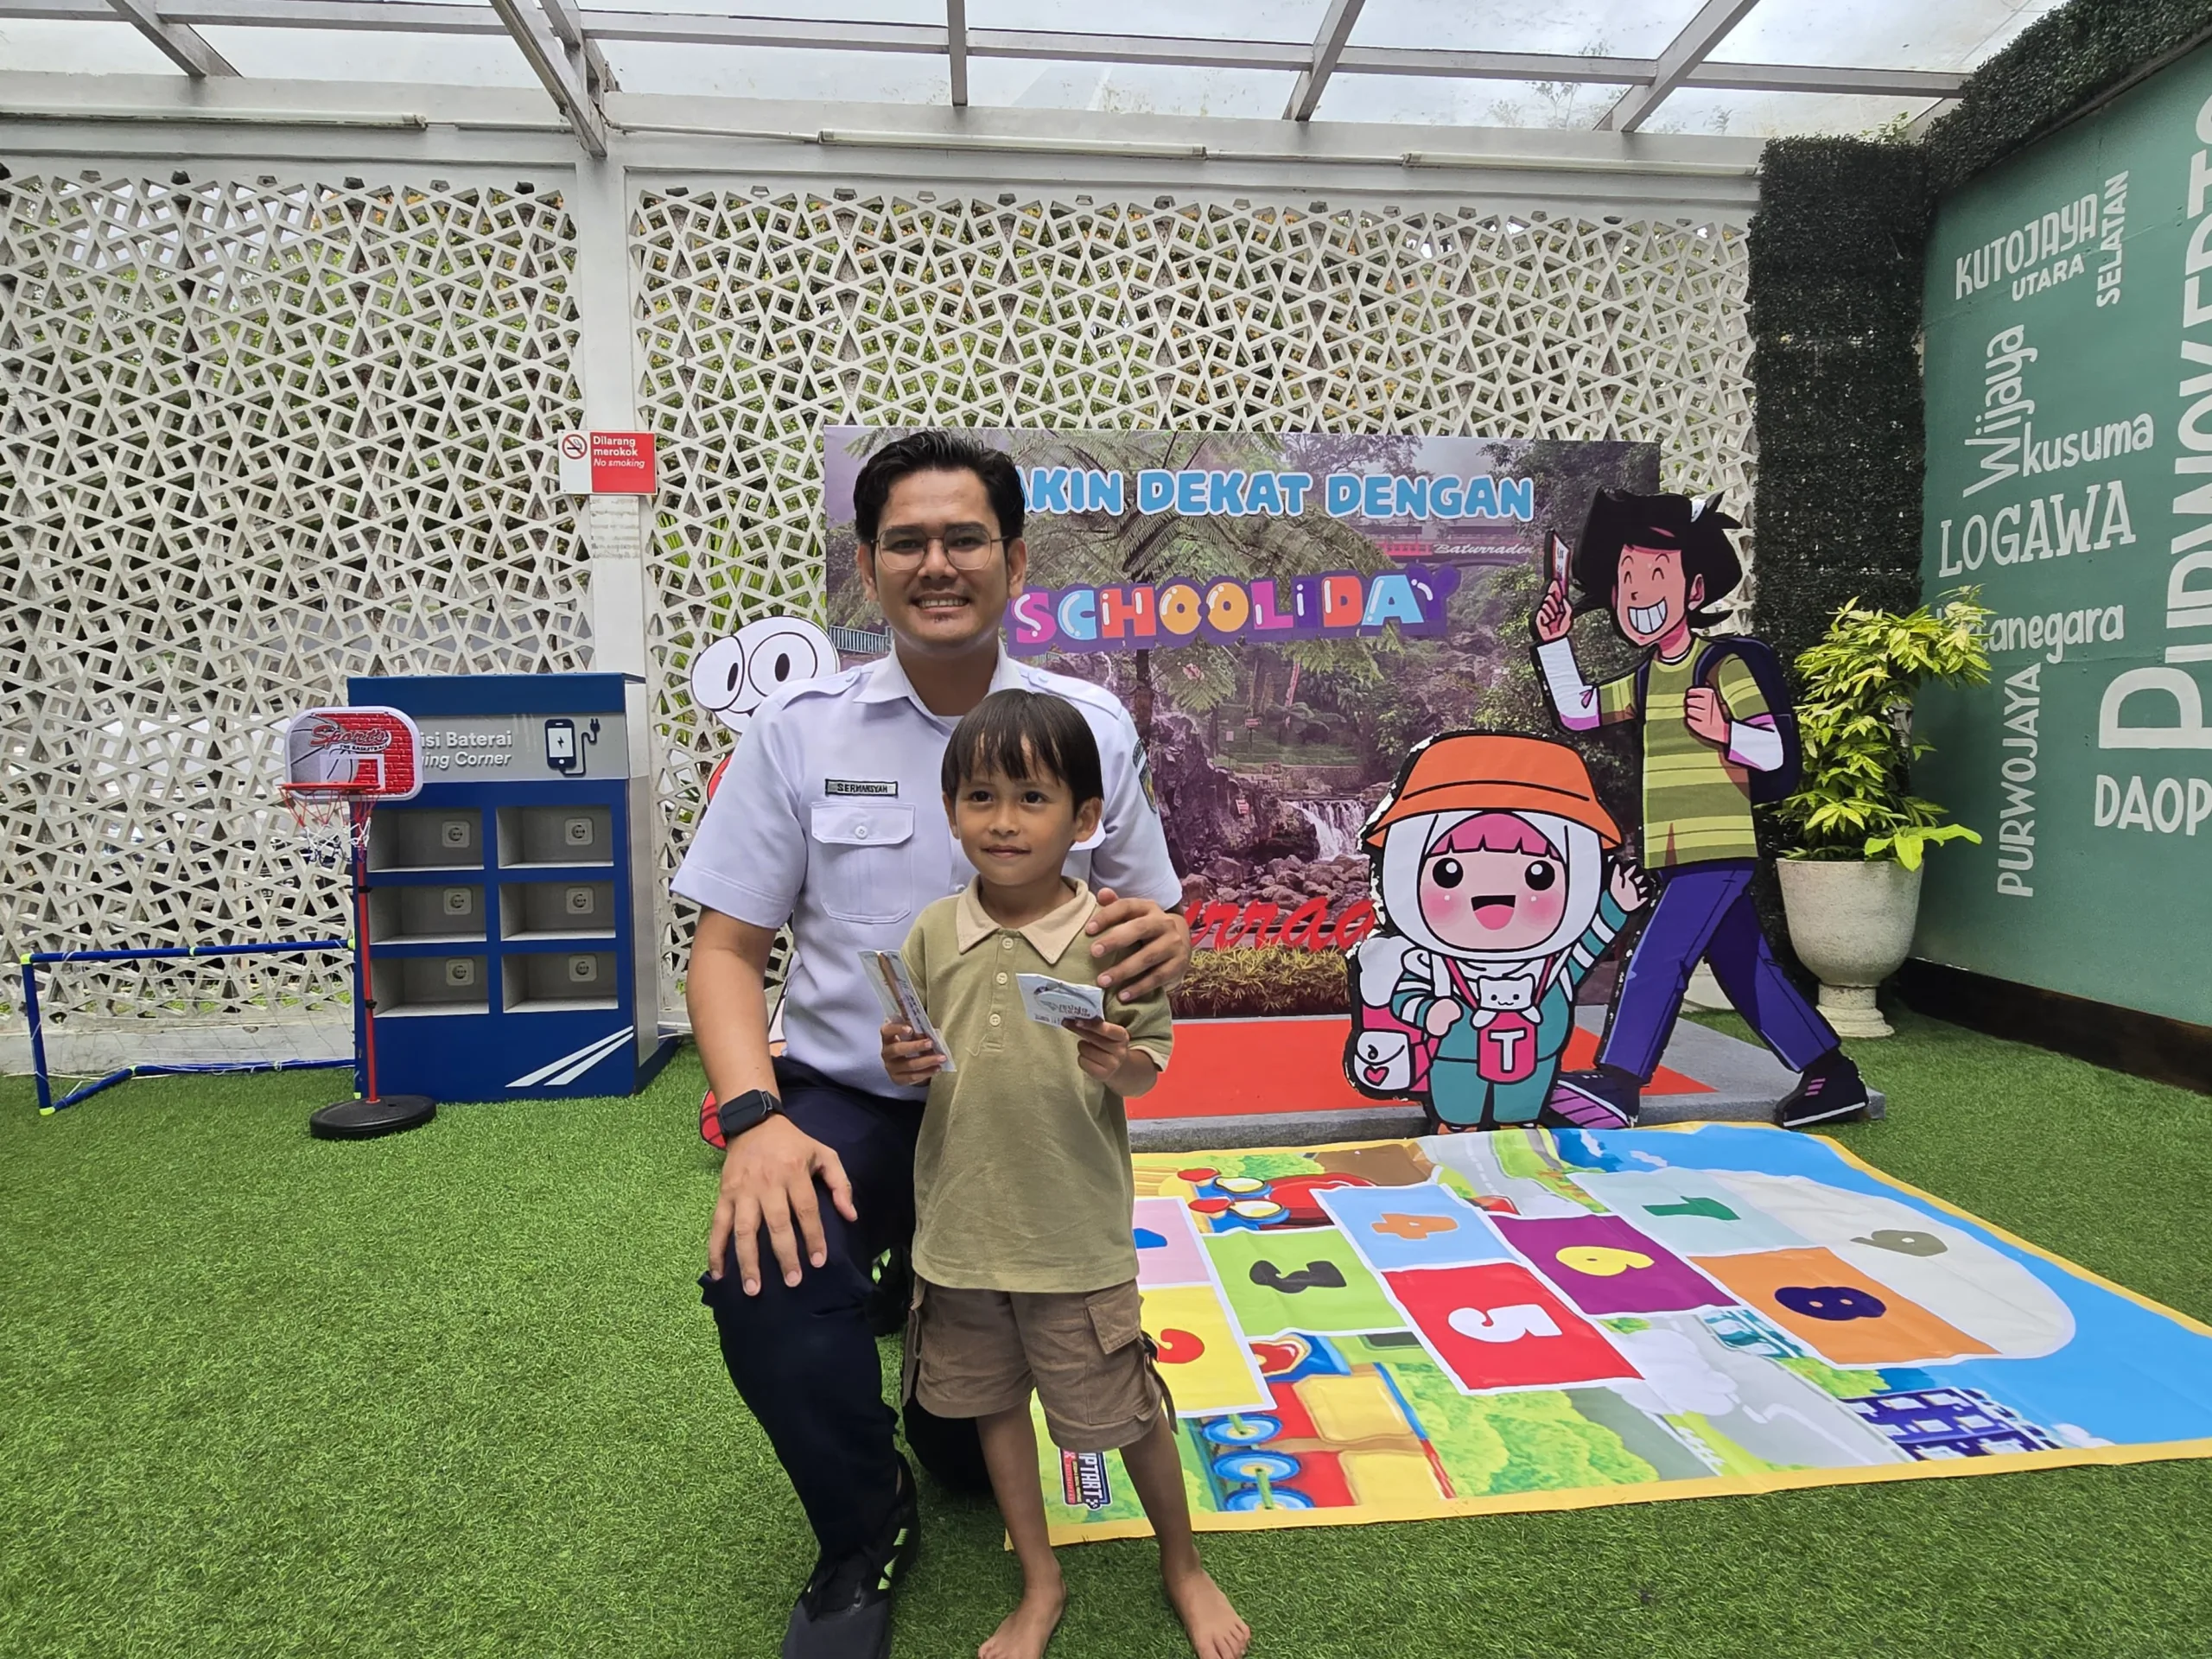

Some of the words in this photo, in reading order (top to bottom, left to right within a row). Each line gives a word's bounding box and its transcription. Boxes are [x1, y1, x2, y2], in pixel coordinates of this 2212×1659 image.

[1955, 193, 2098, 300] KUTOJAYA
[2096, 170, 2129, 308] SELATAN
[2012, 253, 2085, 302] UTARA
[1962, 324, 2038, 498] Wijaya
[593, 435, 636, 448] Dilarang
[593, 448, 639, 456] merokok
[593, 459, 607, 467] No
[608, 459, 645, 469] smoking
[2022, 413, 2154, 478] kusuma
[1014, 466, 1124, 517] KIN
[1138, 468, 1313, 518] DEKAT
[1325, 473, 1534, 520] DENGAN
[1938, 480, 2137, 578] LOGAWA
[422, 752, 450, 769] ing
[454, 751, 512, 766] Corner
[446, 730, 512, 747] Baterai
[1997, 662, 2042, 897] PURWOJAYA
[2094, 774, 2212, 836] DAOP
[1490, 1028, 1526, 1071] T
[1249, 1260, 1347, 1294] 3
[1447, 1304, 1562, 1343] 5
[1774, 1286, 1887, 1321] 8
